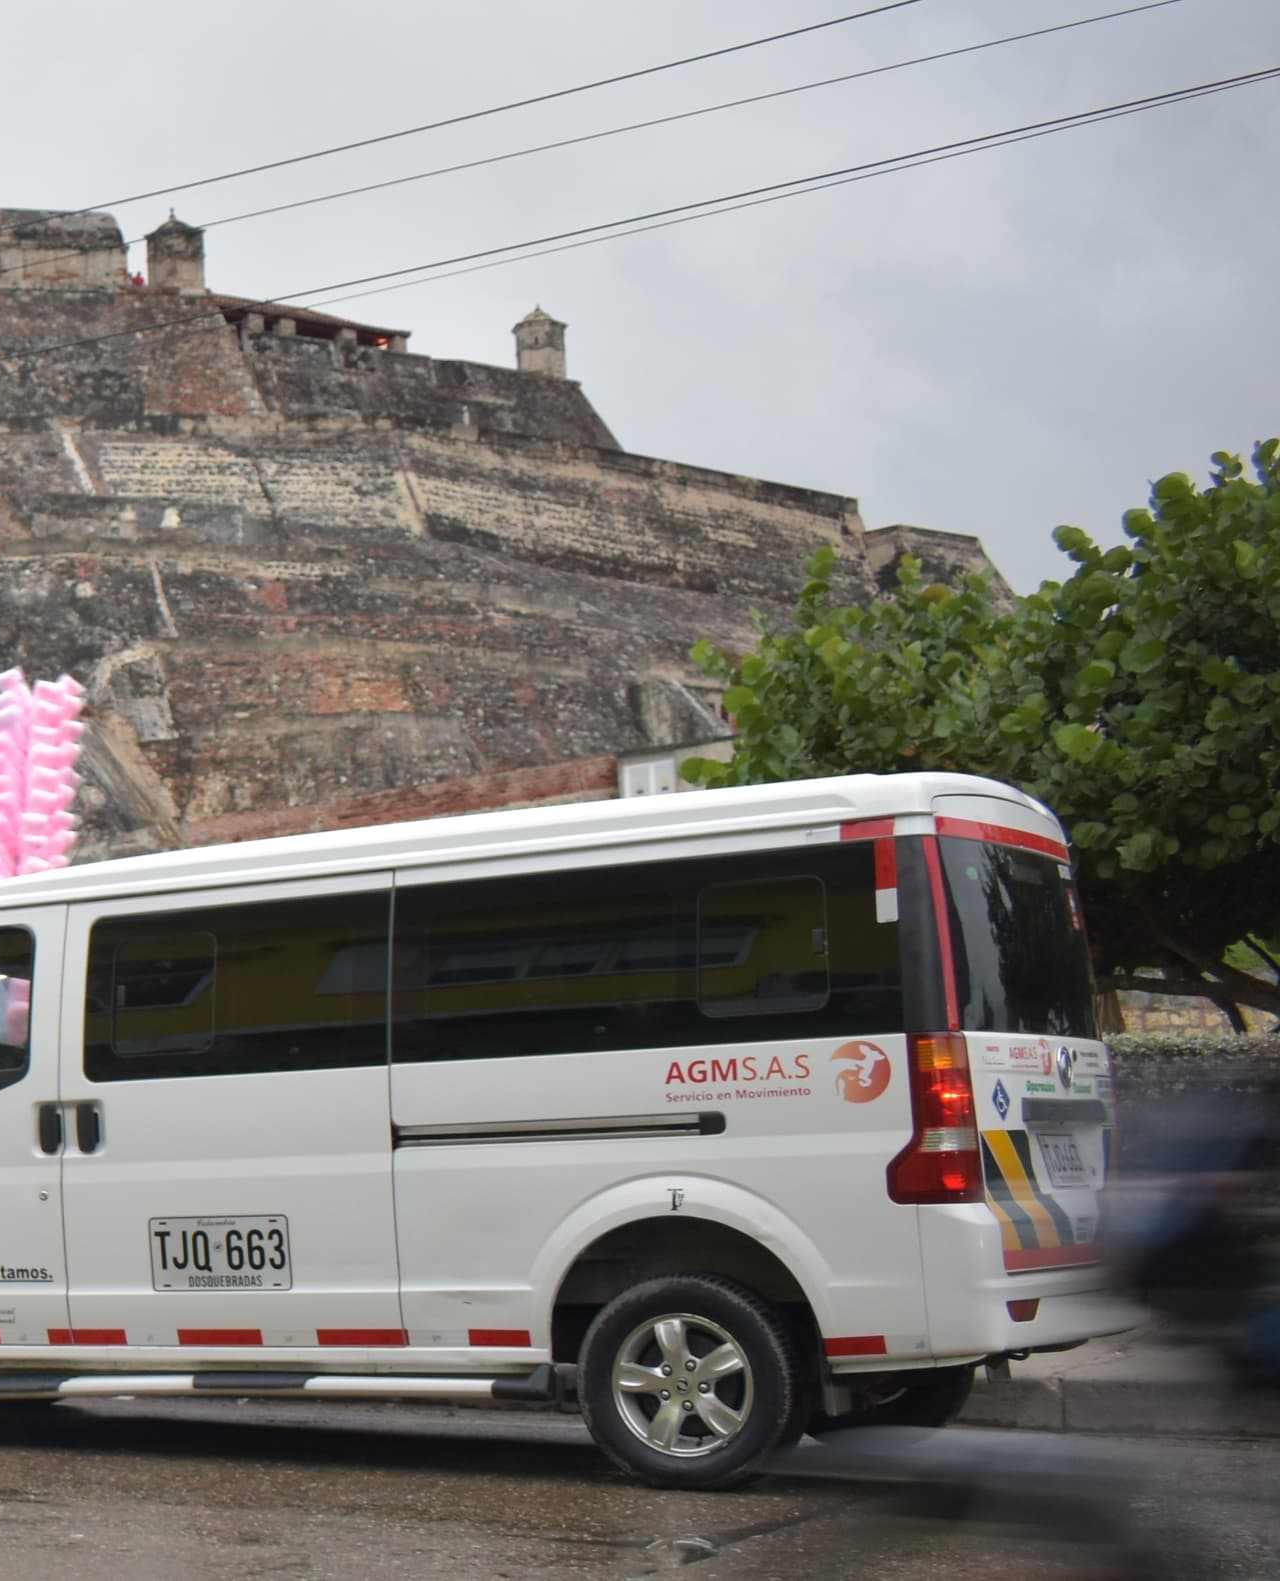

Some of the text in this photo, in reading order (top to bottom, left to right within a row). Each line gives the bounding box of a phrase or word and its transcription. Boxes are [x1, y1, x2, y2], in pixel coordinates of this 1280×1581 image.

[665, 1086, 811, 1103] Servicio en Movimiento
[153, 1228, 286, 1272] TJQ 663
[188, 1275, 263, 1288] DOSQUEBRADAS
